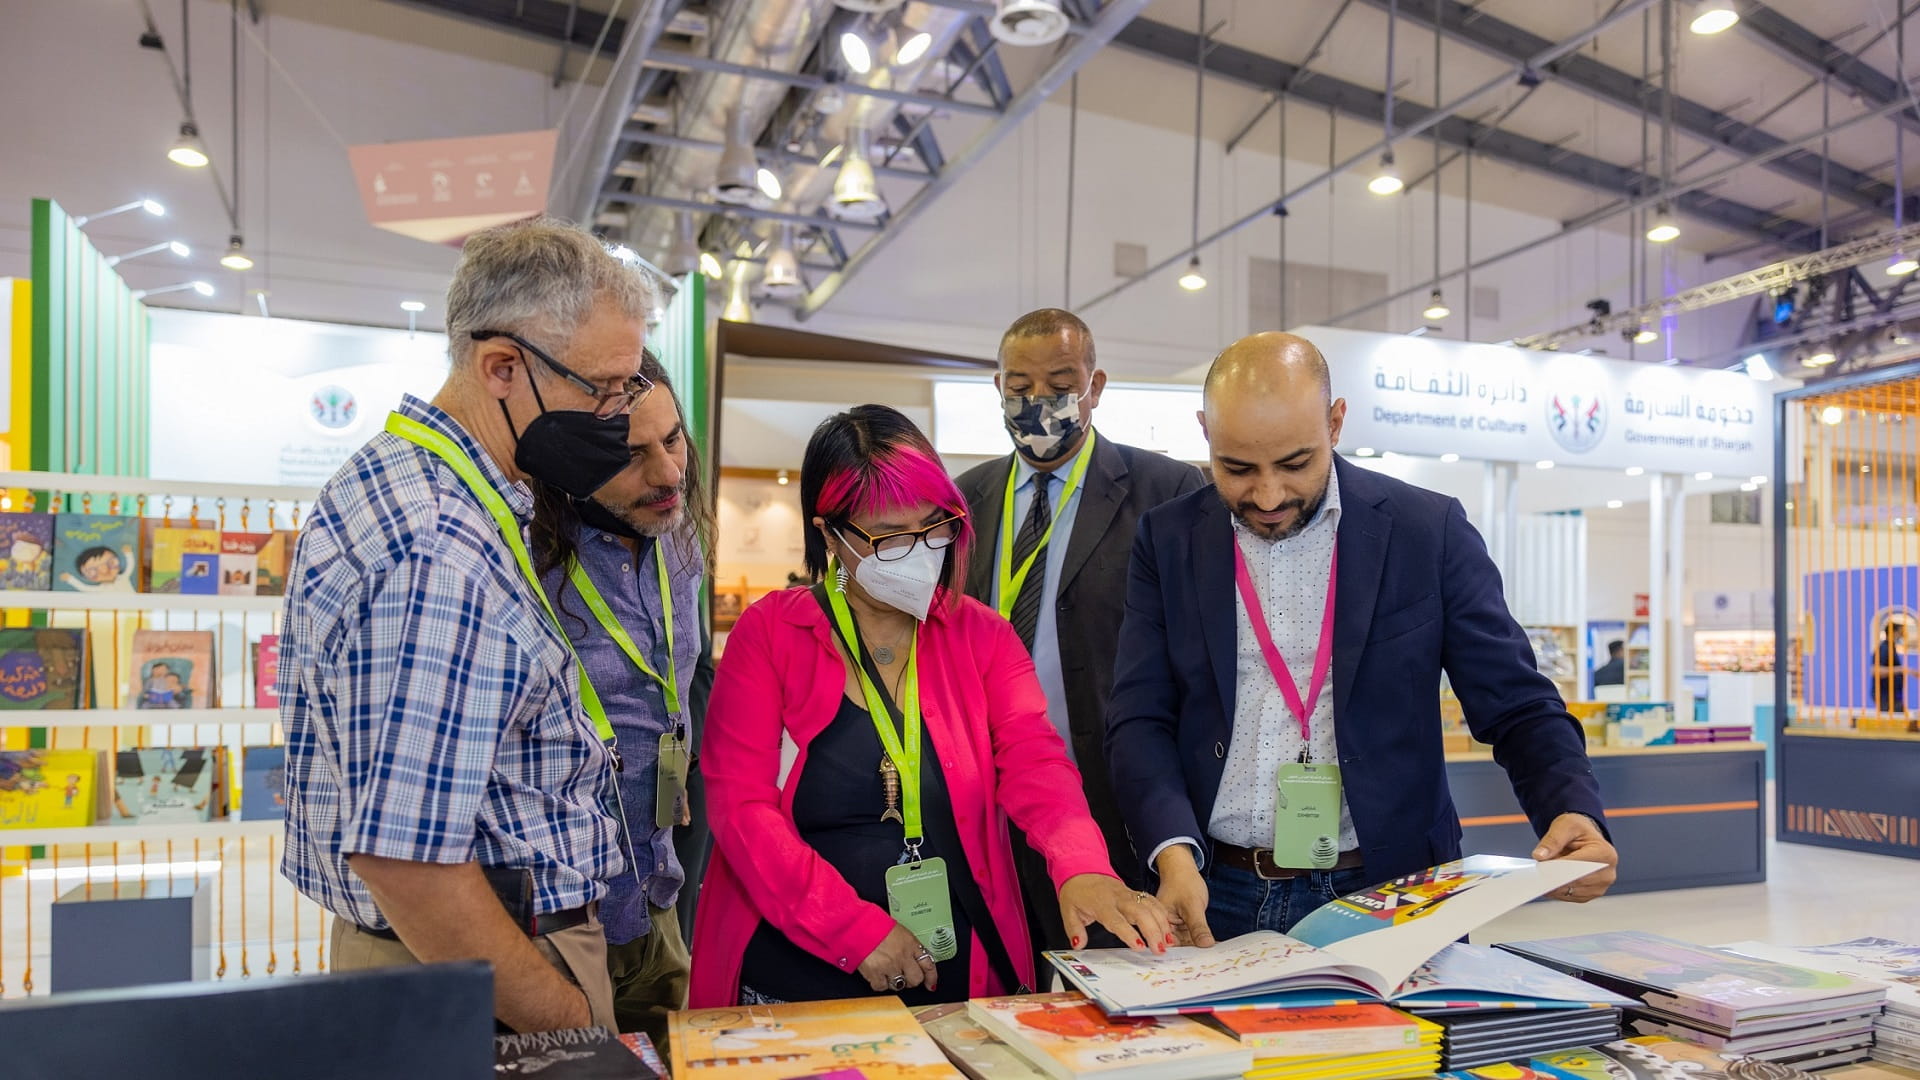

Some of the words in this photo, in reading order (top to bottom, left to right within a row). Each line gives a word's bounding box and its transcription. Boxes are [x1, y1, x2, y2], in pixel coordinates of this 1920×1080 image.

[1373, 406, 1457, 428] Department
[1459, 417, 1474, 430] of
[1477, 416, 1528, 434] Culture
[1624, 429, 1695, 448] Government
[1697, 437, 1710, 449] of
[1711, 436, 1753, 454] Sharjah
